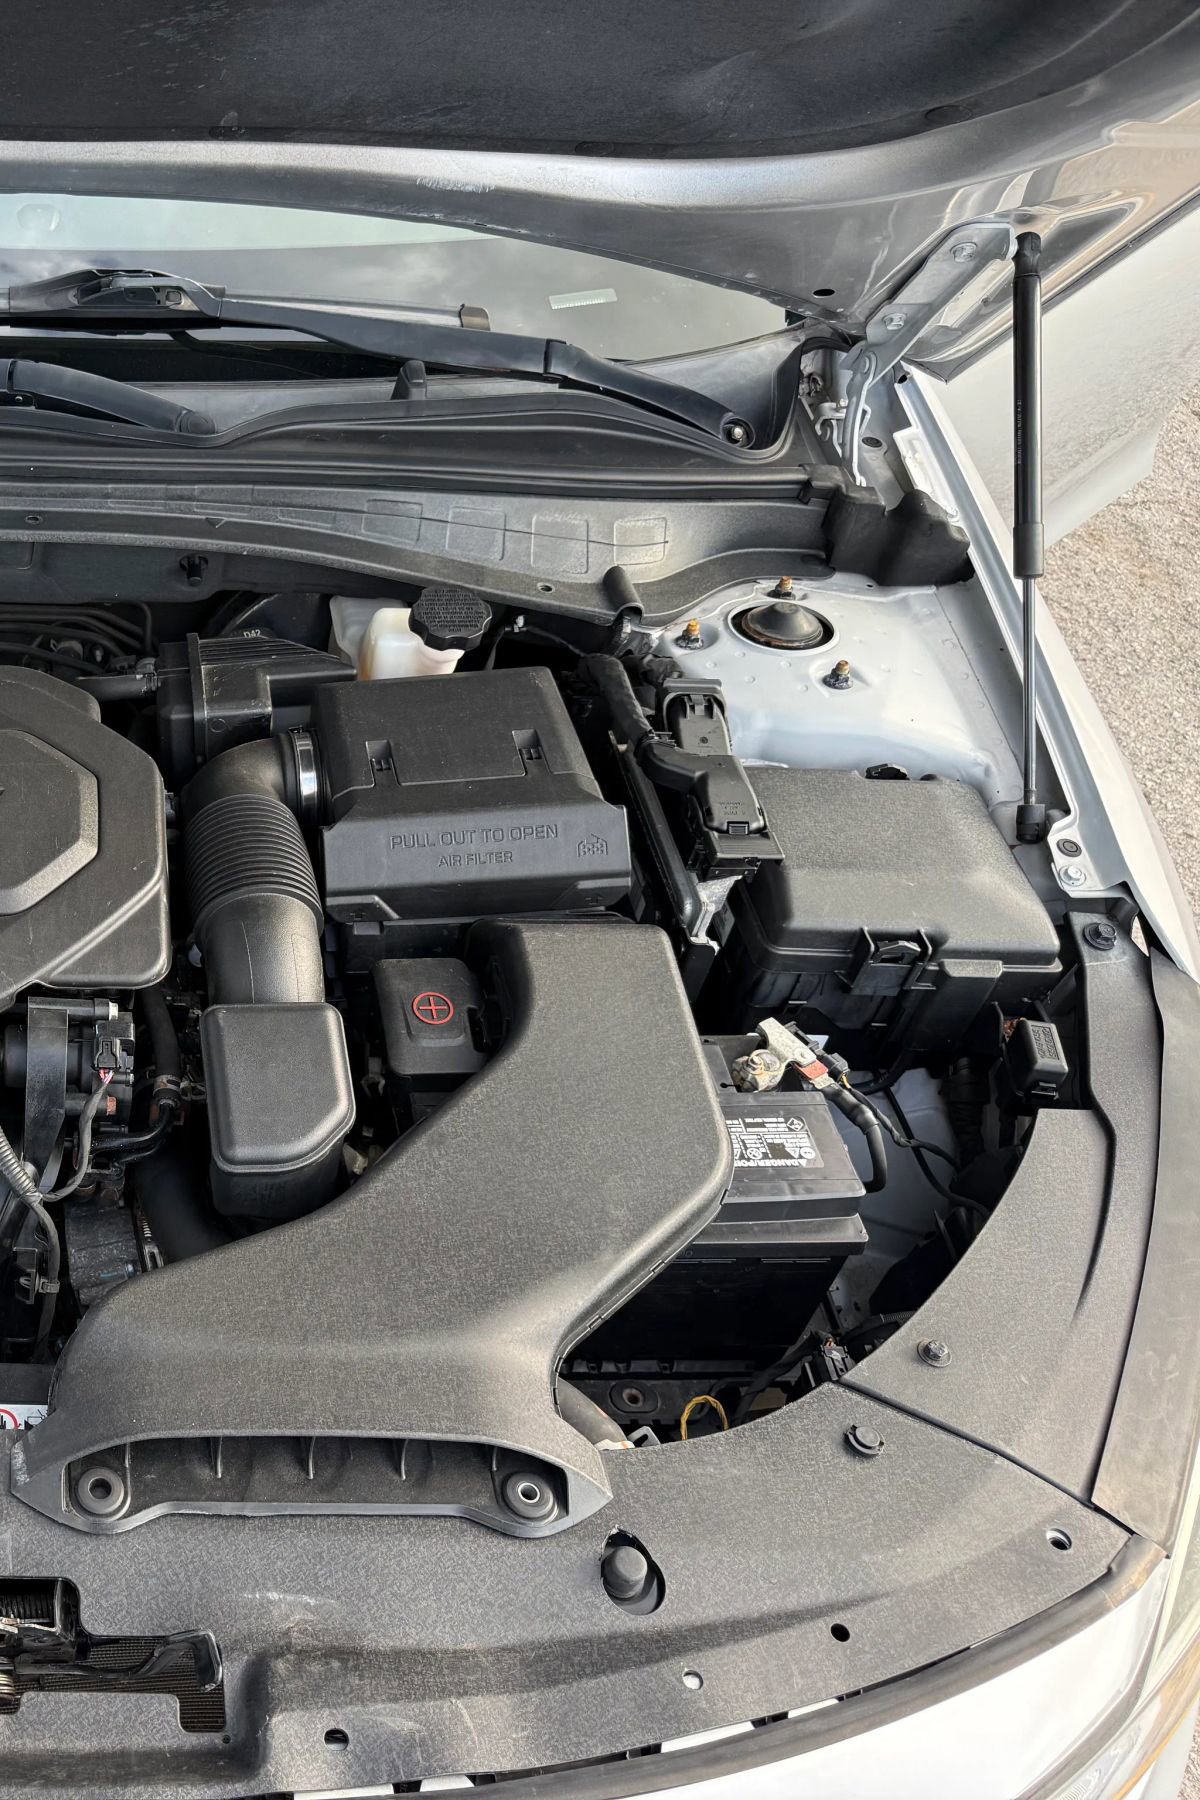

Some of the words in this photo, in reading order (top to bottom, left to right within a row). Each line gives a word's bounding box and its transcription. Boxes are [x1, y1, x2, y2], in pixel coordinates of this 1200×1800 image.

[389, 831, 436, 850] PULL
[439, 829, 476, 847] OUT
[480, 828, 508, 844] TO
[510, 823, 559, 842] OPEN
[437, 854, 462, 868] AIR
[465, 851, 513, 866] FILTER
[734, 1158, 798, 1167] DANGER/POI
